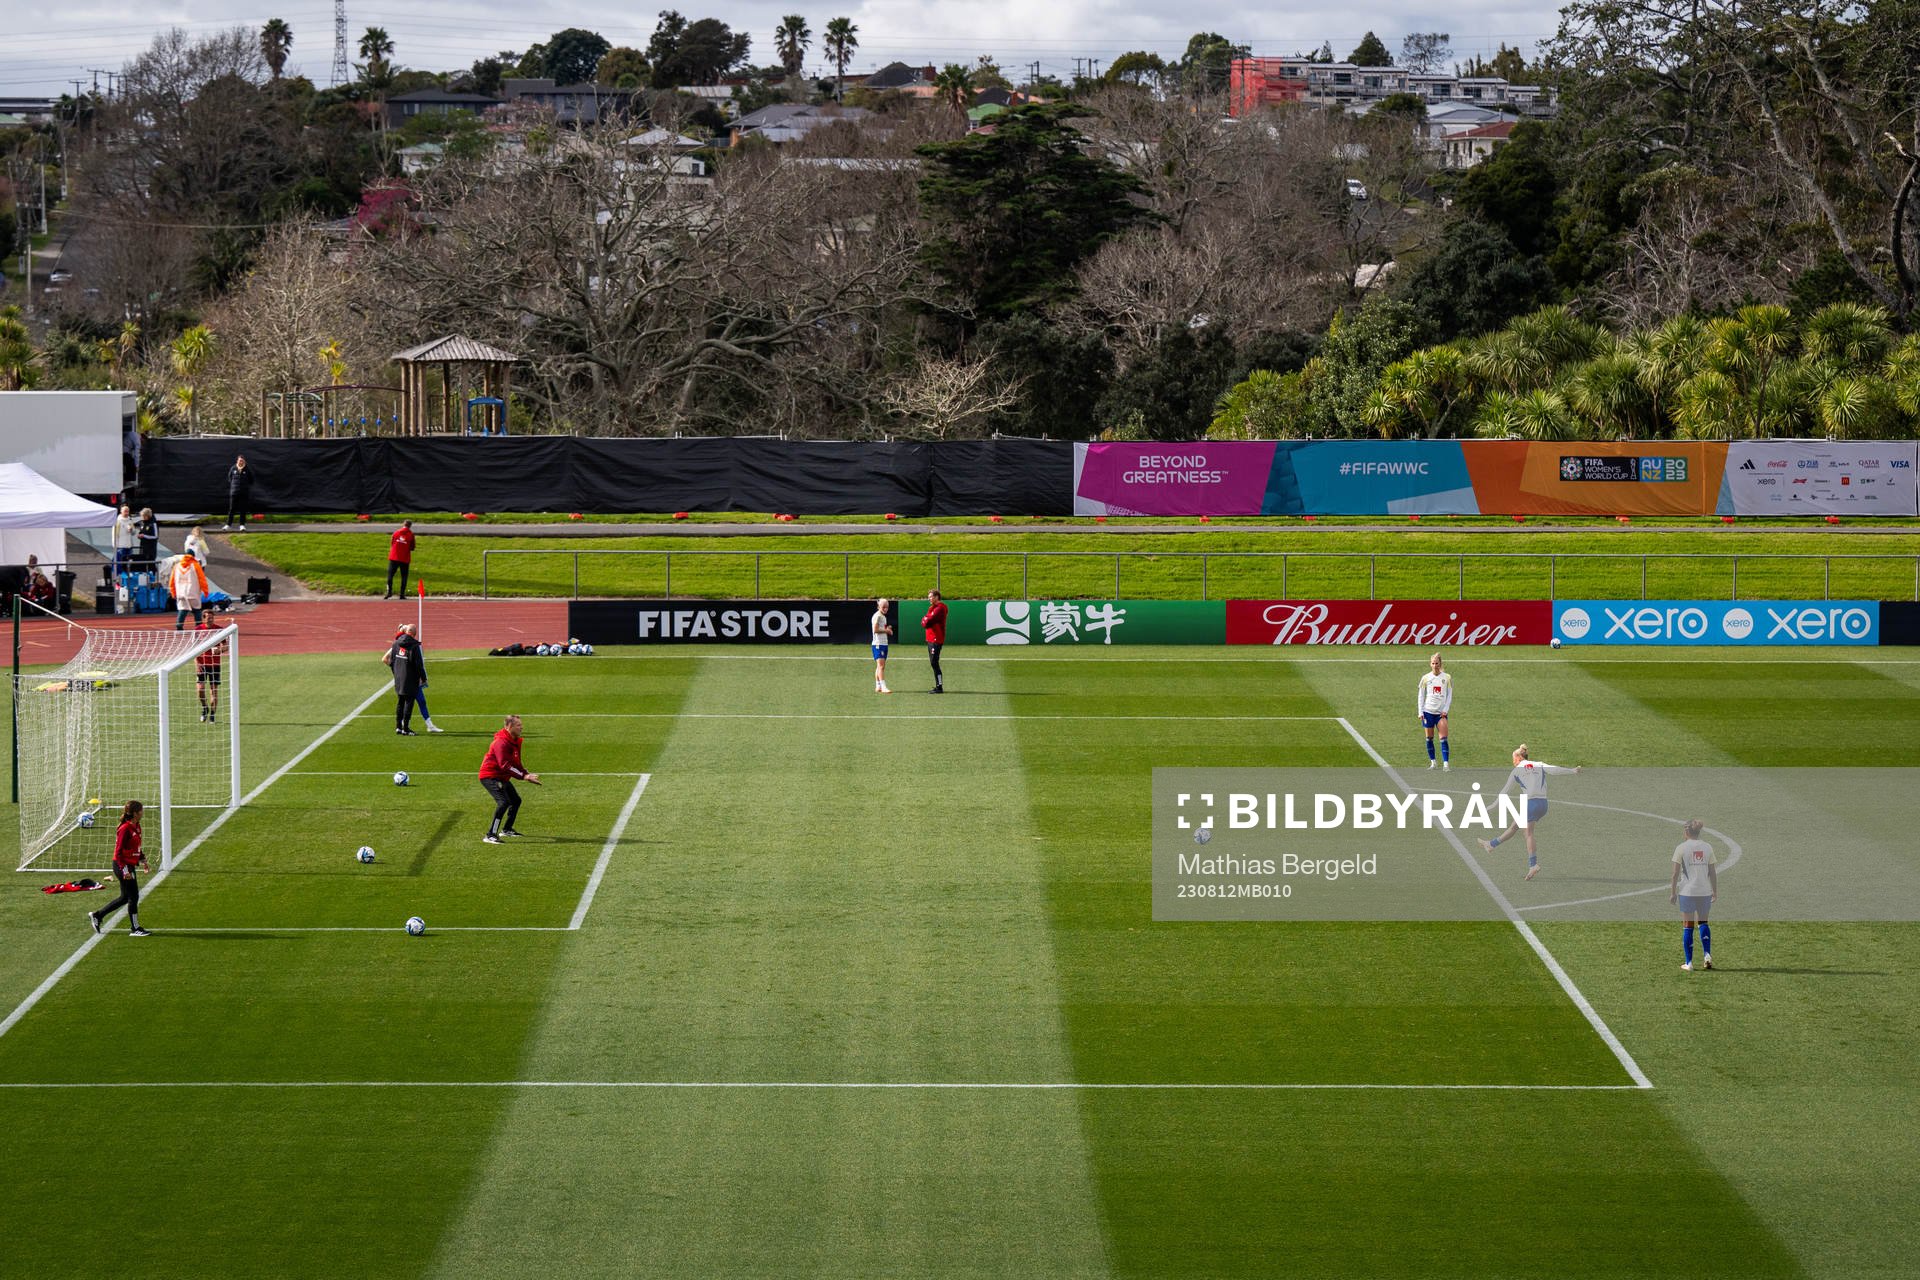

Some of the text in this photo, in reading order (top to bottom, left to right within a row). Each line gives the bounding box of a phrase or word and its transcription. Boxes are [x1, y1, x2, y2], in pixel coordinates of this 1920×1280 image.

[1139, 455, 1207, 468] BEYOND
[1584, 458, 1604, 466] FIFA
[1641, 459, 1662, 470] AU
[1665, 459, 1686, 469] 20
[1890, 460, 1910, 468] VISA
[1339, 462, 1429, 475] #FIFAWWC
[1584, 472, 1628, 480] WORLD CUP
[1641, 469, 1662, 480] NZ
[1665, 469, 1686, 480] 23
[720, 610, 830, 638] STORE
[1039, 601, 1127, 645] 蒙牛
[1262, 603, 1518, 646] Budweiser
[1563, 619, 1588, 627] xero
[1604, 607, 1709, 639] xero
[1725, 619, 1750, 627] xero
[1767, 608, 1872, 640] xero
